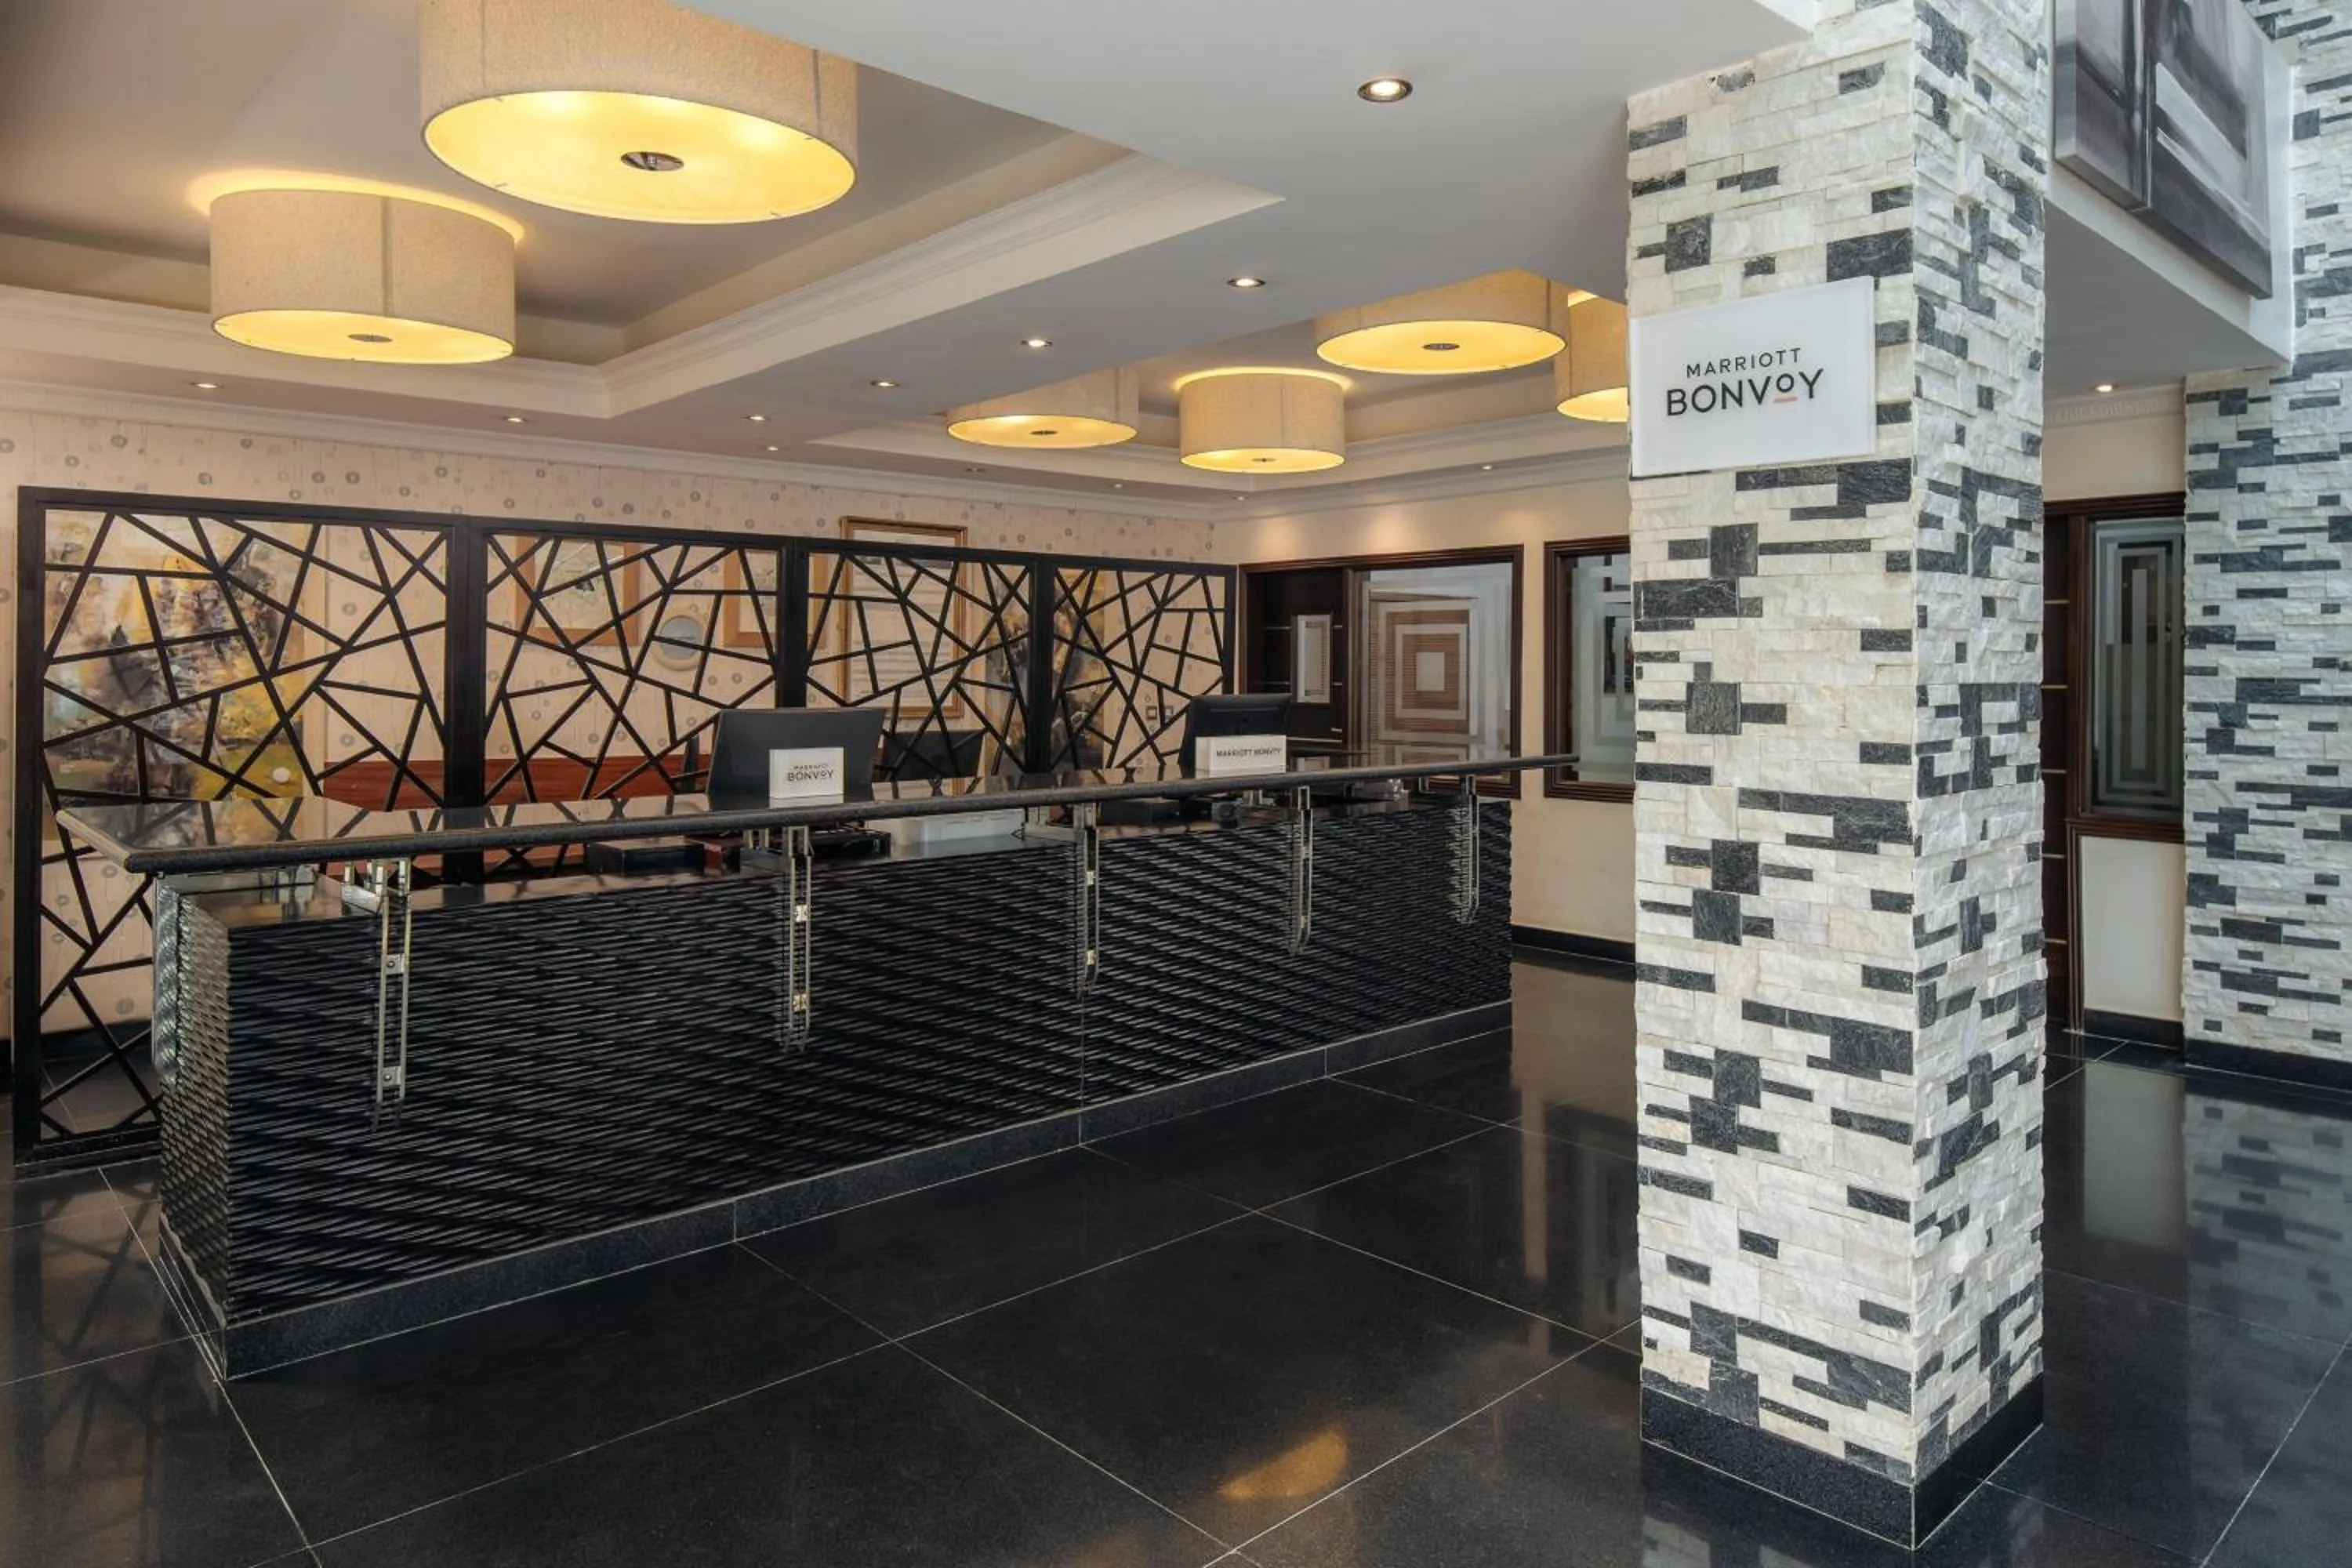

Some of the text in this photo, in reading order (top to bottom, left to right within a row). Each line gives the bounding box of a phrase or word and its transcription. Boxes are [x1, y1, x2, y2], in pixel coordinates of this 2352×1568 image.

[1686, 347, 1801, 378] MARRIOTT
[1667, 368, 1824, 416] BONVOY
[787, 770, 833, 782] BONVOY
